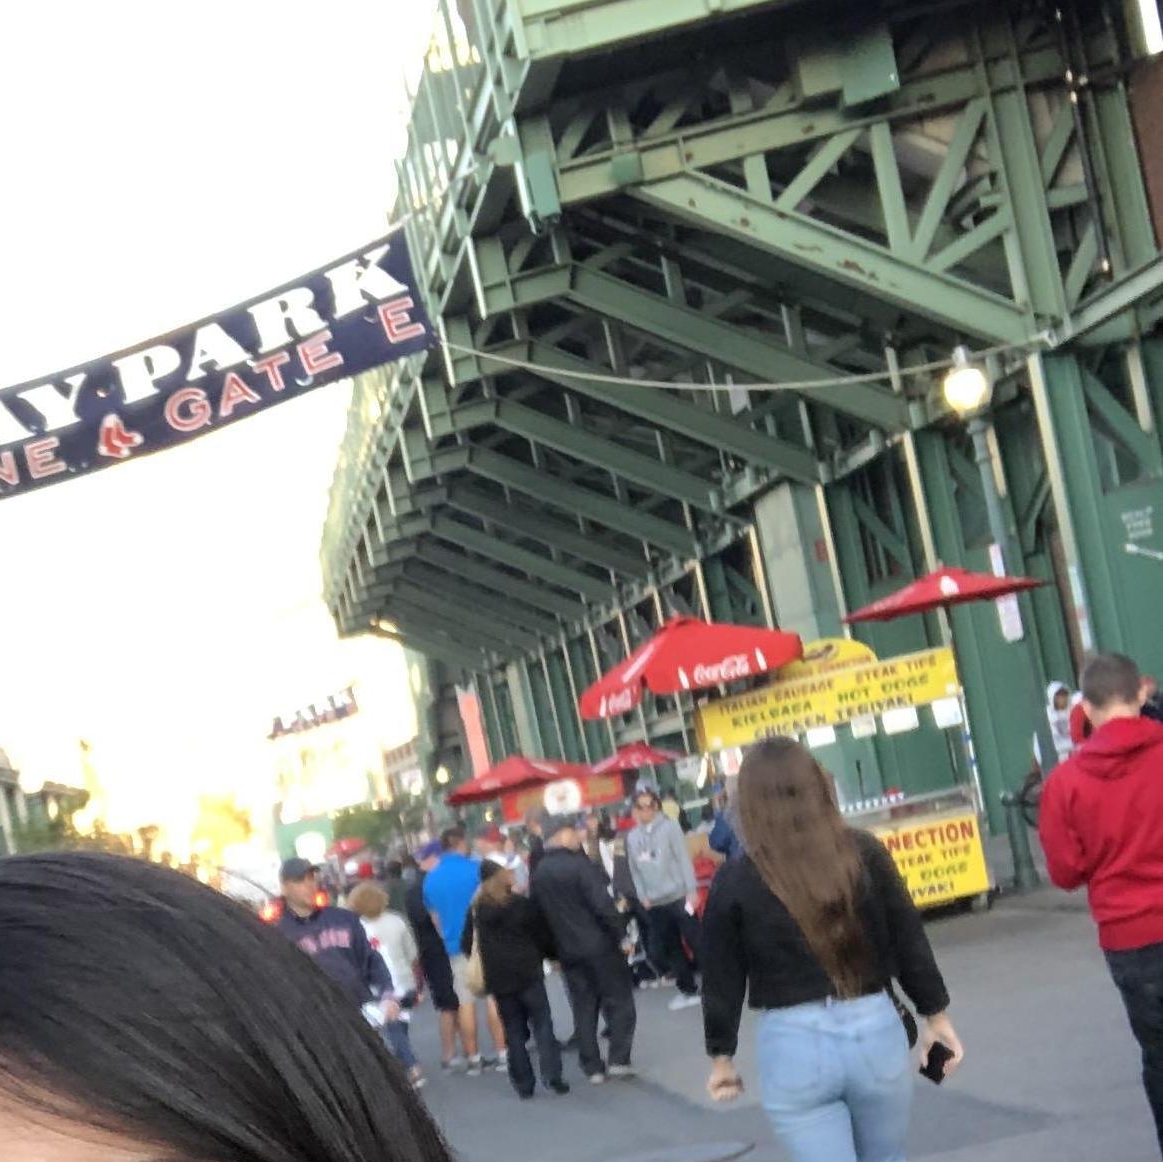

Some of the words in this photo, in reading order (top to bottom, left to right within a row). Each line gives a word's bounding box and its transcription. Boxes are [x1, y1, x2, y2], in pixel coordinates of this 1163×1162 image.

[112, 244, 409, 405] PARK
[164, 330, 344, 432] GATE
[377, 296, 425, 344] E
[855, 664, 898, 684] STEAK
[906, 654, 936, 673] TIPS
[837, 692, 913, 720] TERIYAKI
[838, 686, 871, 702] HOT
